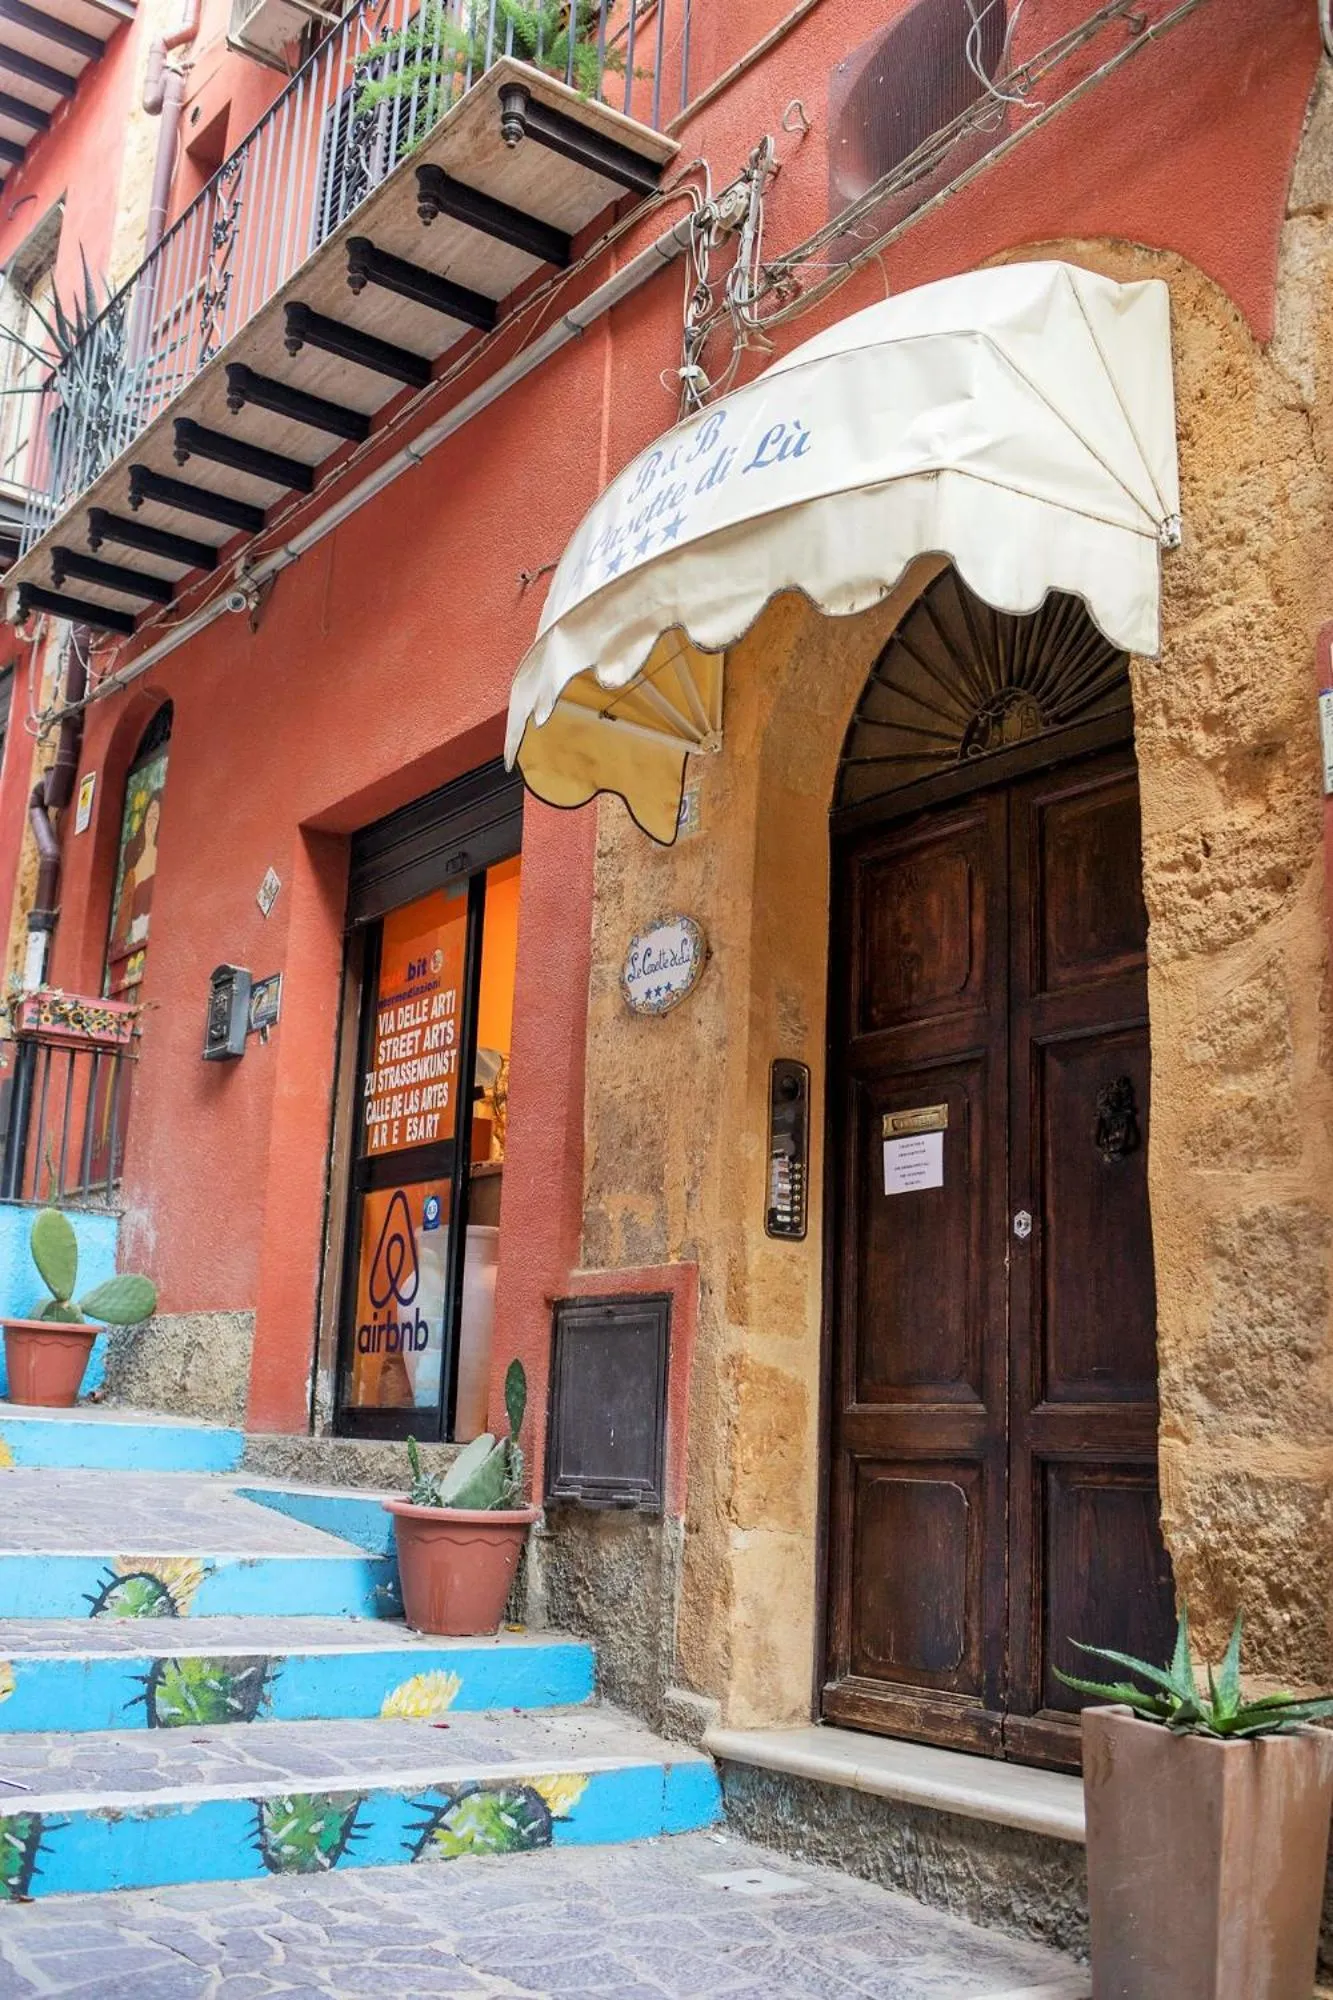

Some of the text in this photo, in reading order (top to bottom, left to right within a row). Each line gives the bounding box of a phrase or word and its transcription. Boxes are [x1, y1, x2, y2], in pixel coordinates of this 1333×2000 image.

[627, 450, 664, 505] B
[685, 409, 728, 464] B
[694, 445, 740, 497] di
[741, 418, 812, 475] Lù
[407, 957, 427, 981] bit
[378, 989, 456, 1037] VIA DELLE ARTI
[378, 1019, 455, 1065] STREET ARTS
[364, 1049, 457, 1097] ZU STRASSENKUNST
[366, 1082, 449, 1125] CALLE DE LAS ARTES
[358, 1307, 429, 1354] airbnb
